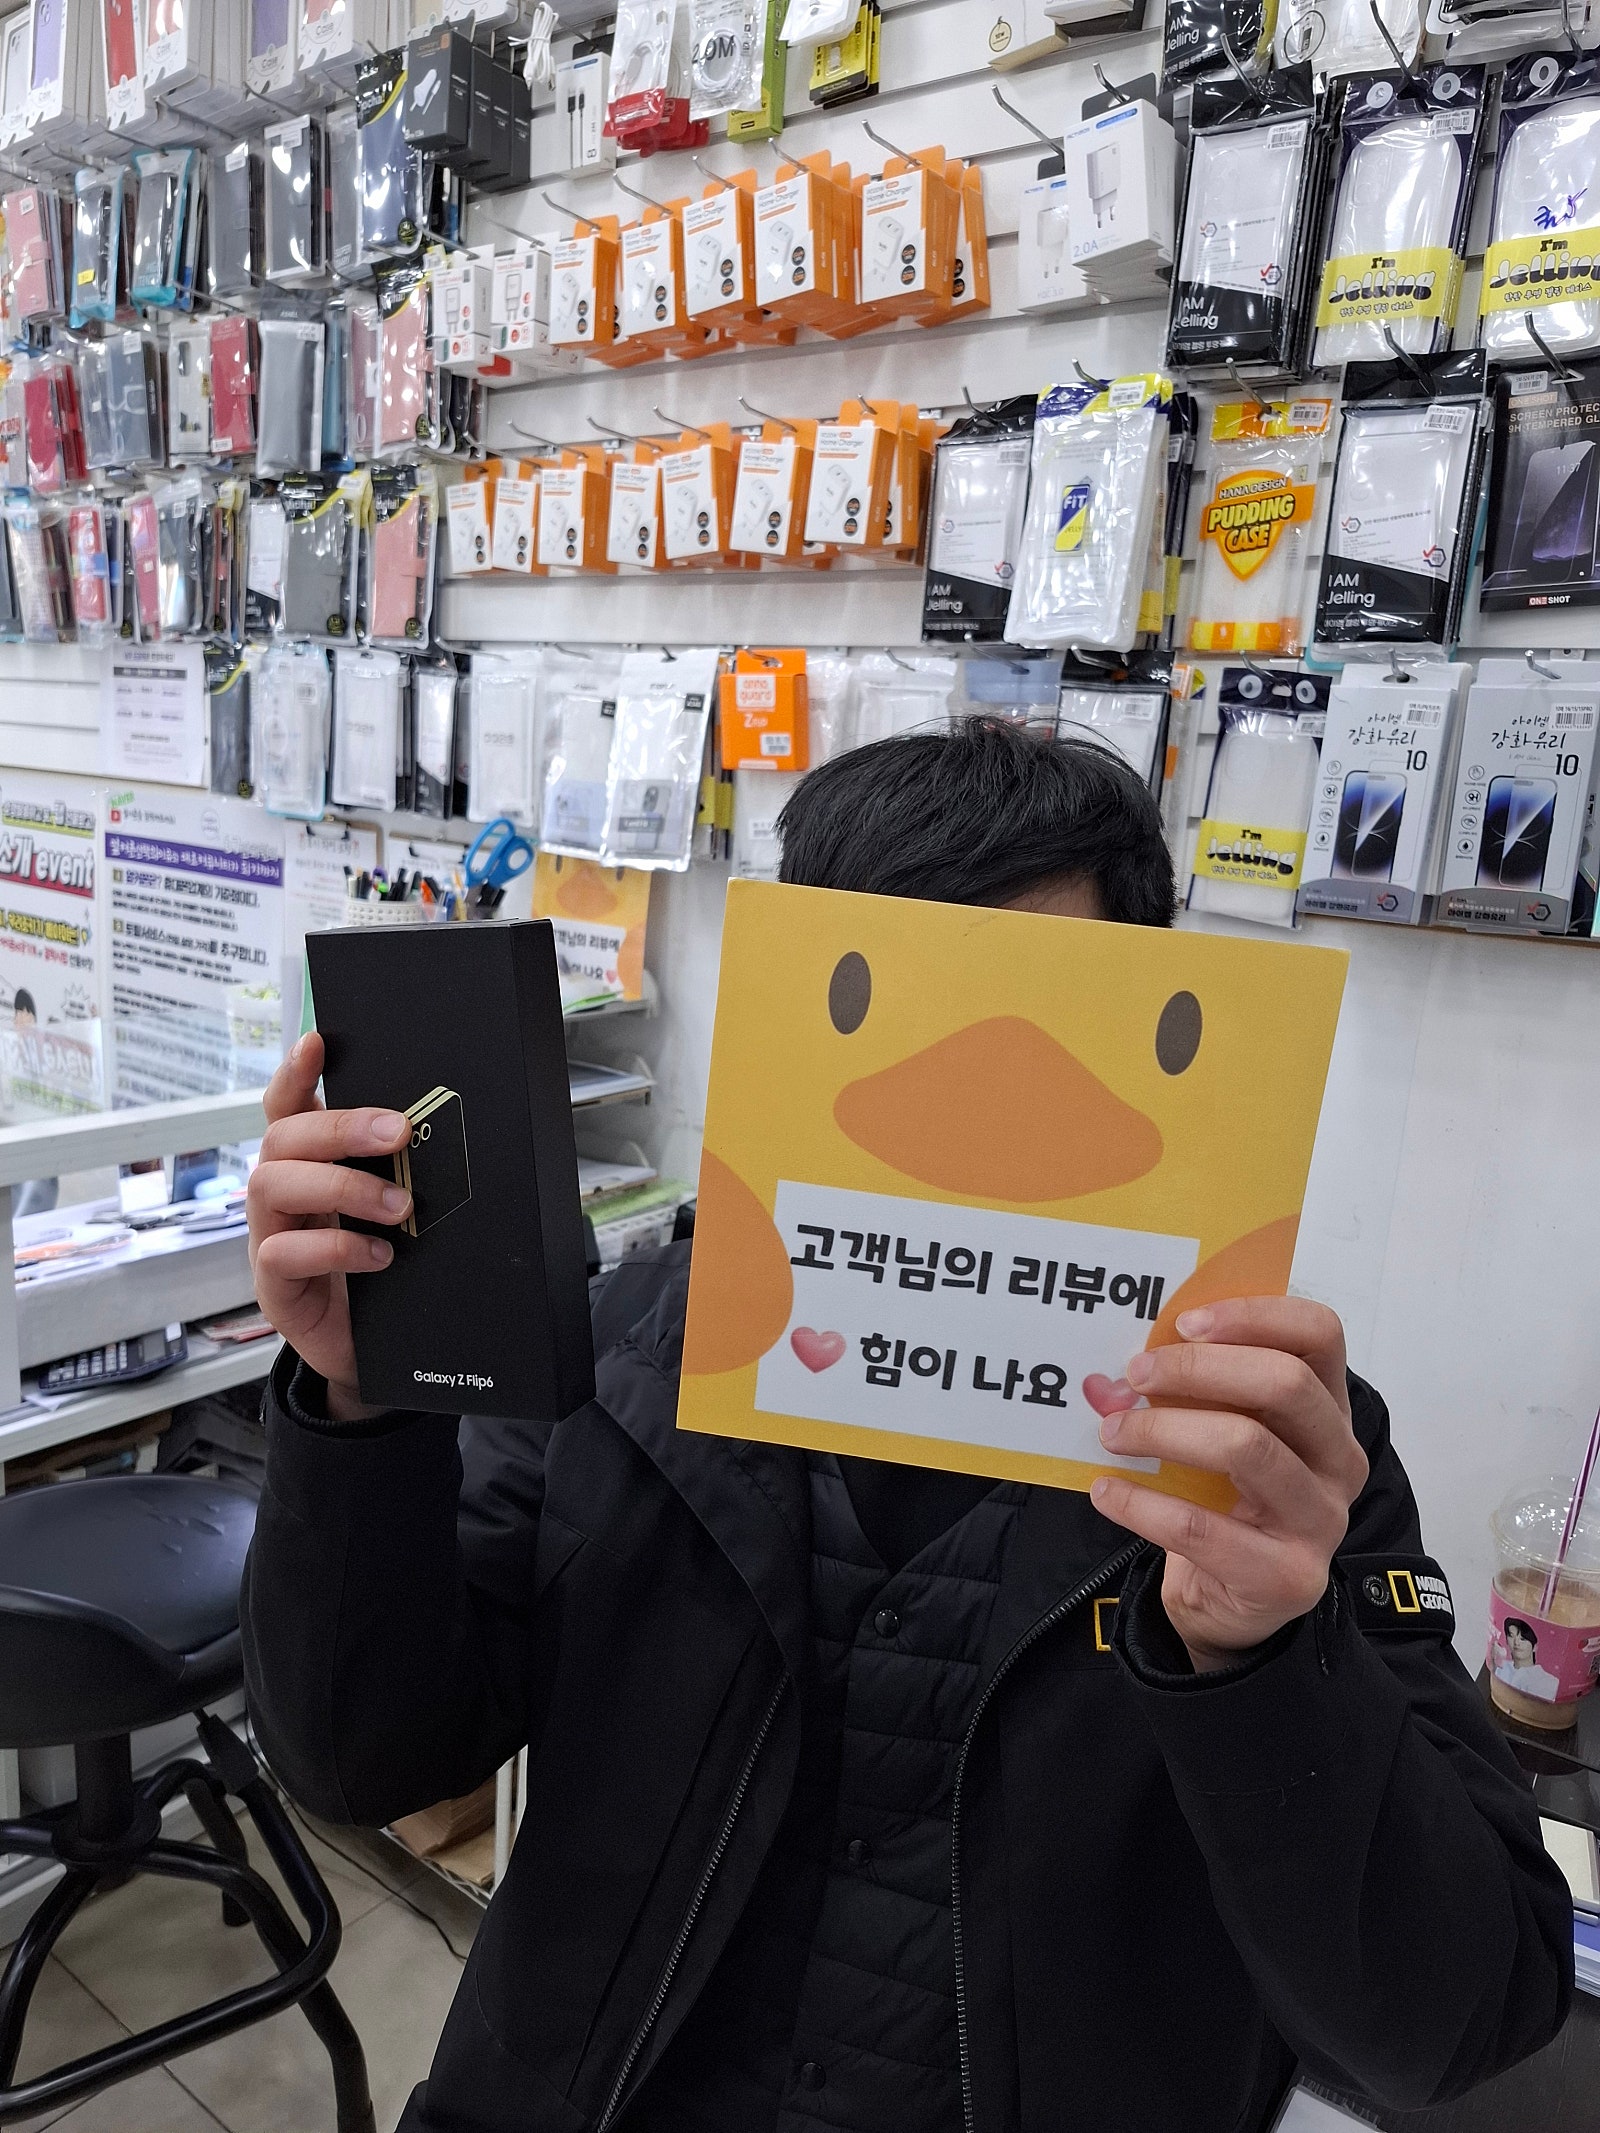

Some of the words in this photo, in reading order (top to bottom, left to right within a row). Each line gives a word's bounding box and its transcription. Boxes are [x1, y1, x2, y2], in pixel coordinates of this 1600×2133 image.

[1165, 28, 1200, 53] Jelling
[887, 184, 912, 198] Charger
[1073, 239, 1099, 258] 2.0A
[1540, 239, 1568, 252] I'm
[1371, 257, 1396, 269] I'm
[1328, 269, 1436, 304] Jelling
[1510, 410, 1553, 422] SCREEN
[1556, 403, 1600, 416] PROTEC
[1508, 424, 1521, 433] 9H
[1524, 416, 1582, 430] TEMPERED
[1585, 415, 1600, 424] GL
[1250, 478, 1288, 494] DESIGN
[1063, 495, 1088, 510] FIT
[1208, 494, 1295, 532] PUDDING
[1327, 575, 1332, 587] I
[1334, 573, 1360, 587] AM
[931, 584, 951, 597] AM
[1325, 590, 1376, 608] Jelling
[1548, 595, 1571, 604] SHOT
[925, 598, 964, 614] Jelling
[1512, 715, 1550, 728] 아이엠
[1348, 728, 1417, 746] 강화유리
[1491, 731, 1566, 750] 강화유리
[1406, 750, 1427, 771] 10
[1555, 754, 1580, 776] 10
[1241, 829, 1262, 841] I'm
[1207, 837, 1297, 876] Jelling
[35, 847, 95, 890] event
[790, 1223, 993, 1295] 고객님의
[1008, 1256, 1165, 1321] 리뷰에
[860, 1332, 957, 1391] 힘이
[972, 1355, 1068, 1408] 나요
[413, 1370, 456, 1388] Galaxy
[457, 1374, 465, 1385] Z
[466, 1374, 494, 1391] Flip6
